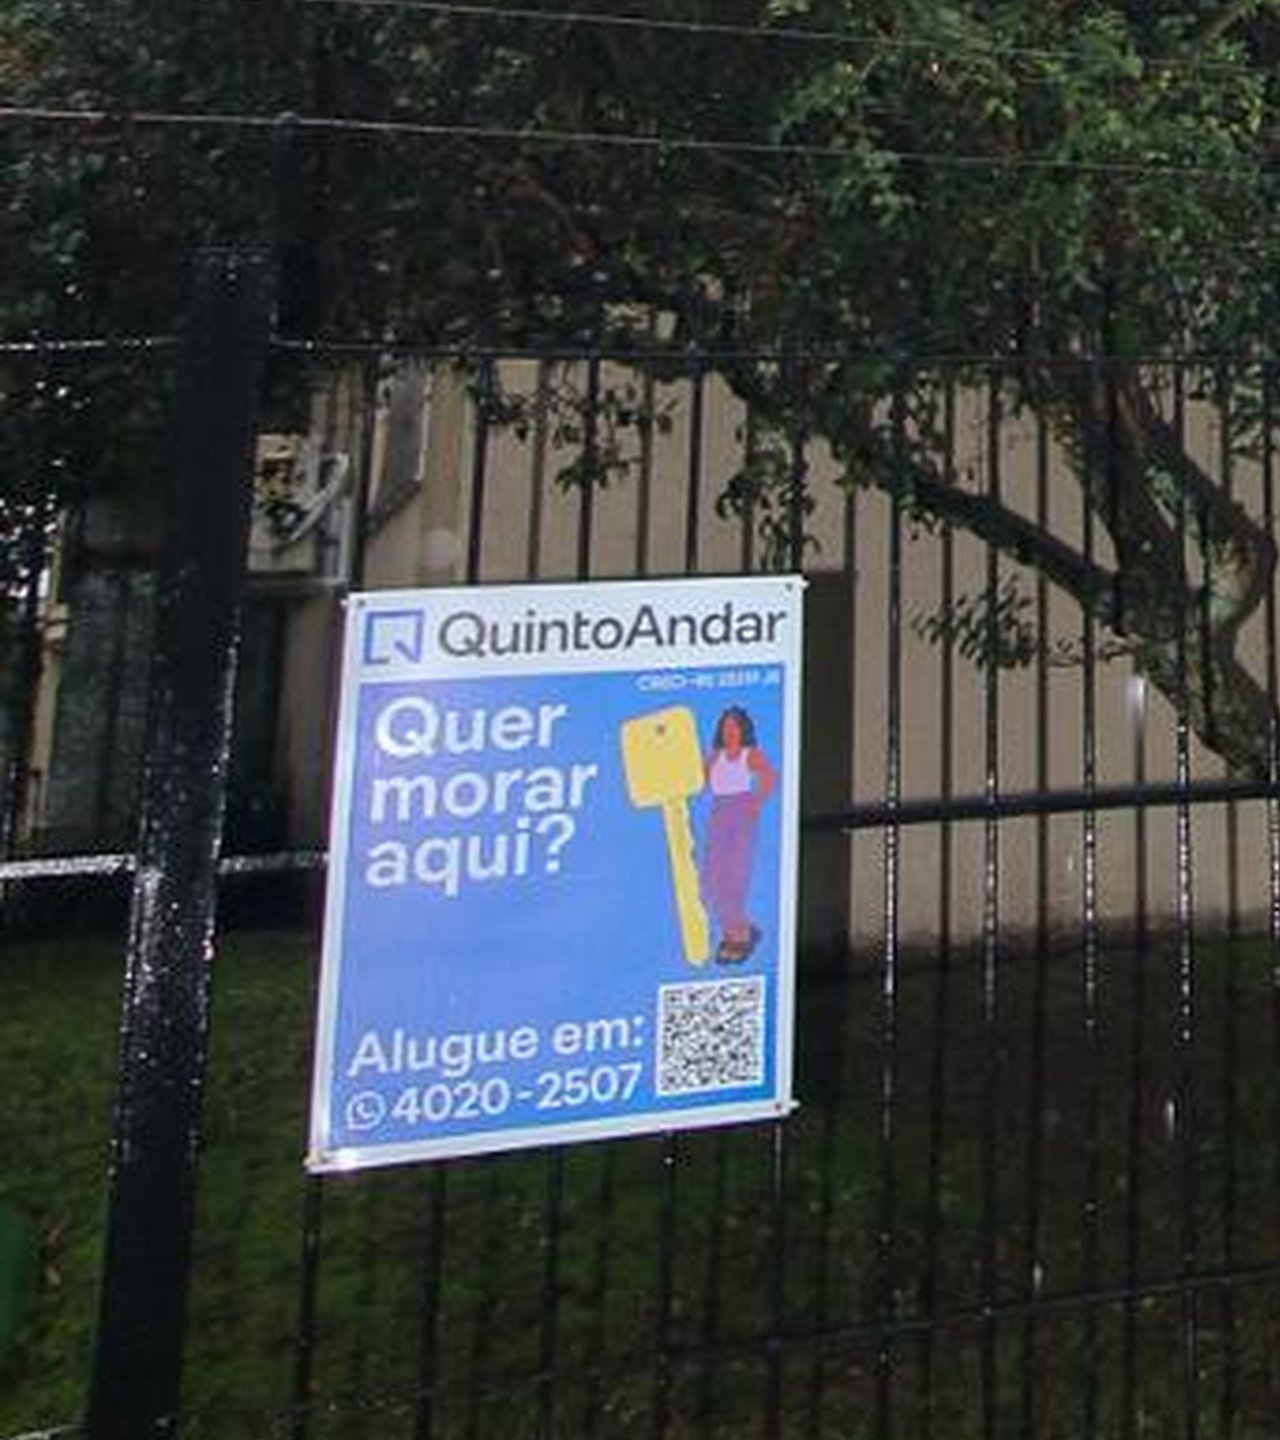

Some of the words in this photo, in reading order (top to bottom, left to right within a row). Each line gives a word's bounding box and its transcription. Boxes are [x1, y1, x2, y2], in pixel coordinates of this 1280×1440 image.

[438, 602, 787, 657] QuintoAndar
[375, 696, 567, 756] Quer
[373, 762, 597, 821] morar
[366, 814, 575, 896] aqui?
[349, 1028, 537, 1078] Alugue
[553, 1016, 645, 1054] em:
